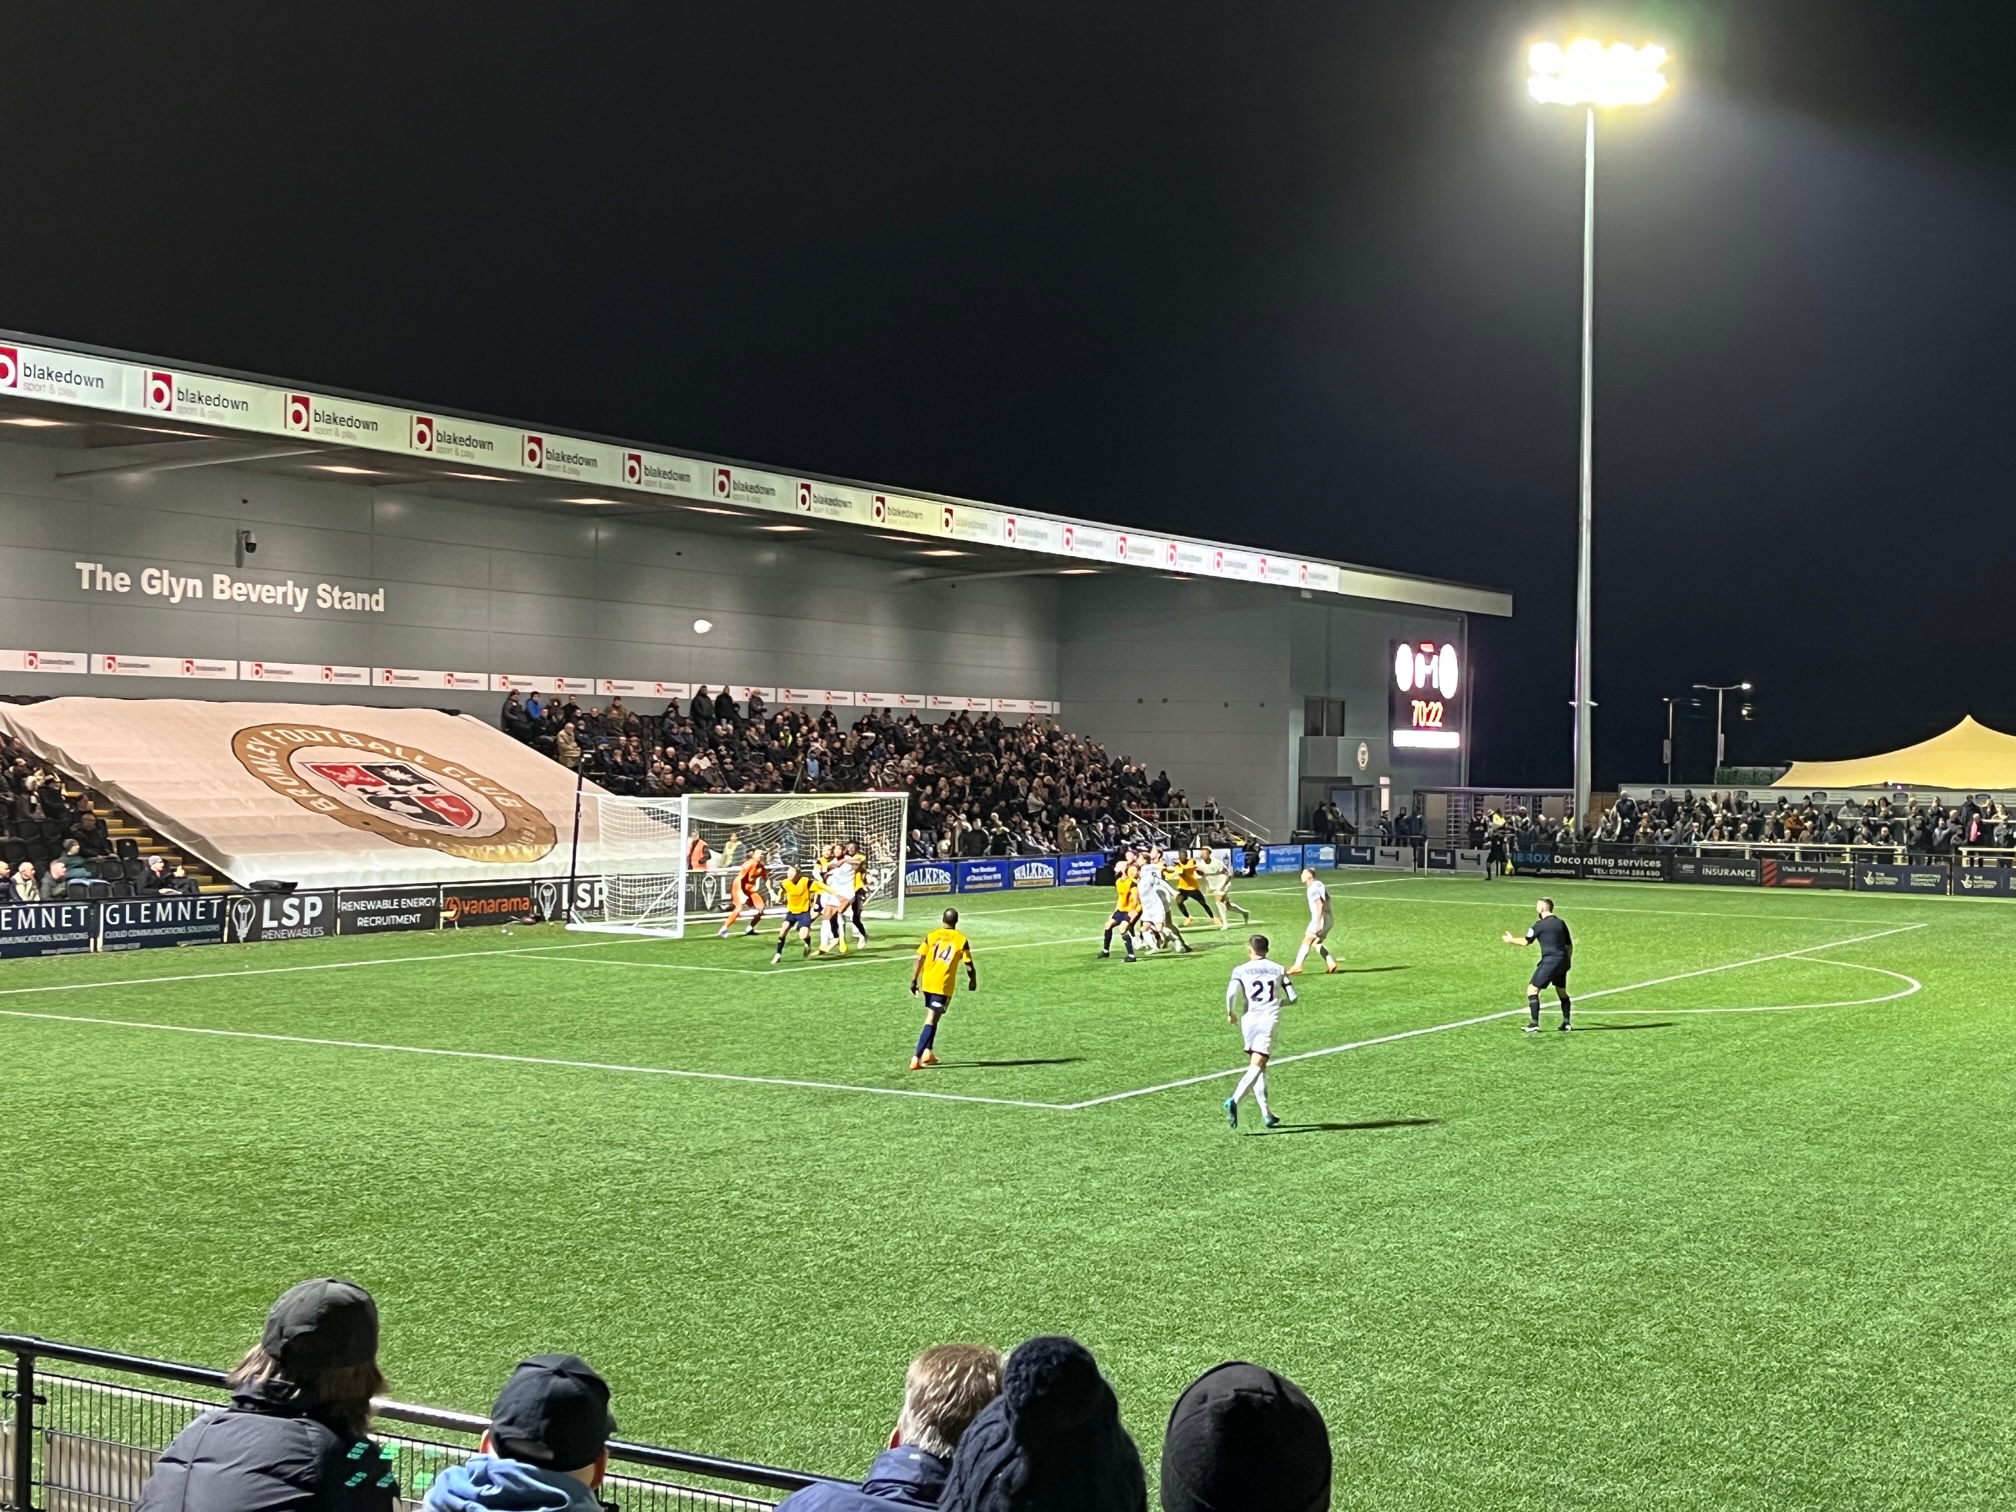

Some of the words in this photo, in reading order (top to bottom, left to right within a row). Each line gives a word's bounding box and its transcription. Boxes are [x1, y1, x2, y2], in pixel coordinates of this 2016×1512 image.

[23, 363, 104, 389] blakedown
[177, 387, 249, 412] blakedown
[313, 409, 378, 432] blakedown
[436, 429, 494, 452] blakedown
[546, 448, 597, 468] blakedown
[644, 465, 691, 483] blakedown
[733, 480, 776, 497] blakedown
[75, 562, 131, 593] The
[140, 567, 203, 604] Glyn
[213, 574, 309, 612] Beverly
[316, 583, 385, 612] Stand
[261, 729, 429, 765] FOOTBALL
[245, 736, 340, 812] BROMLEY
[441, 766, 523, 808] CLUB
[1014, 862, 1054, 880] WALKERS
[1617, 857, 1662, 868] services
[1702, 867, 1756, 878] INSURANCE
[906, 868, 951, 886] WALKERS
[106, 899, 223, 925] GLEMNET
[262, 896, 323, 928] LSP
[341, 899, 399, 912] RENEWABLE
[401, 897, 437, 908] ENERGY
[461, 896, 530, 914] vanarama
[1, 906, 88, 931] EMNET
[357, 914, 421, 927] RECRUITMENT
[261, 927, 325, 939] RENEWABLES
[932, 942, 952, 962] 14
[1250, 980, 1274, 1002] 21
